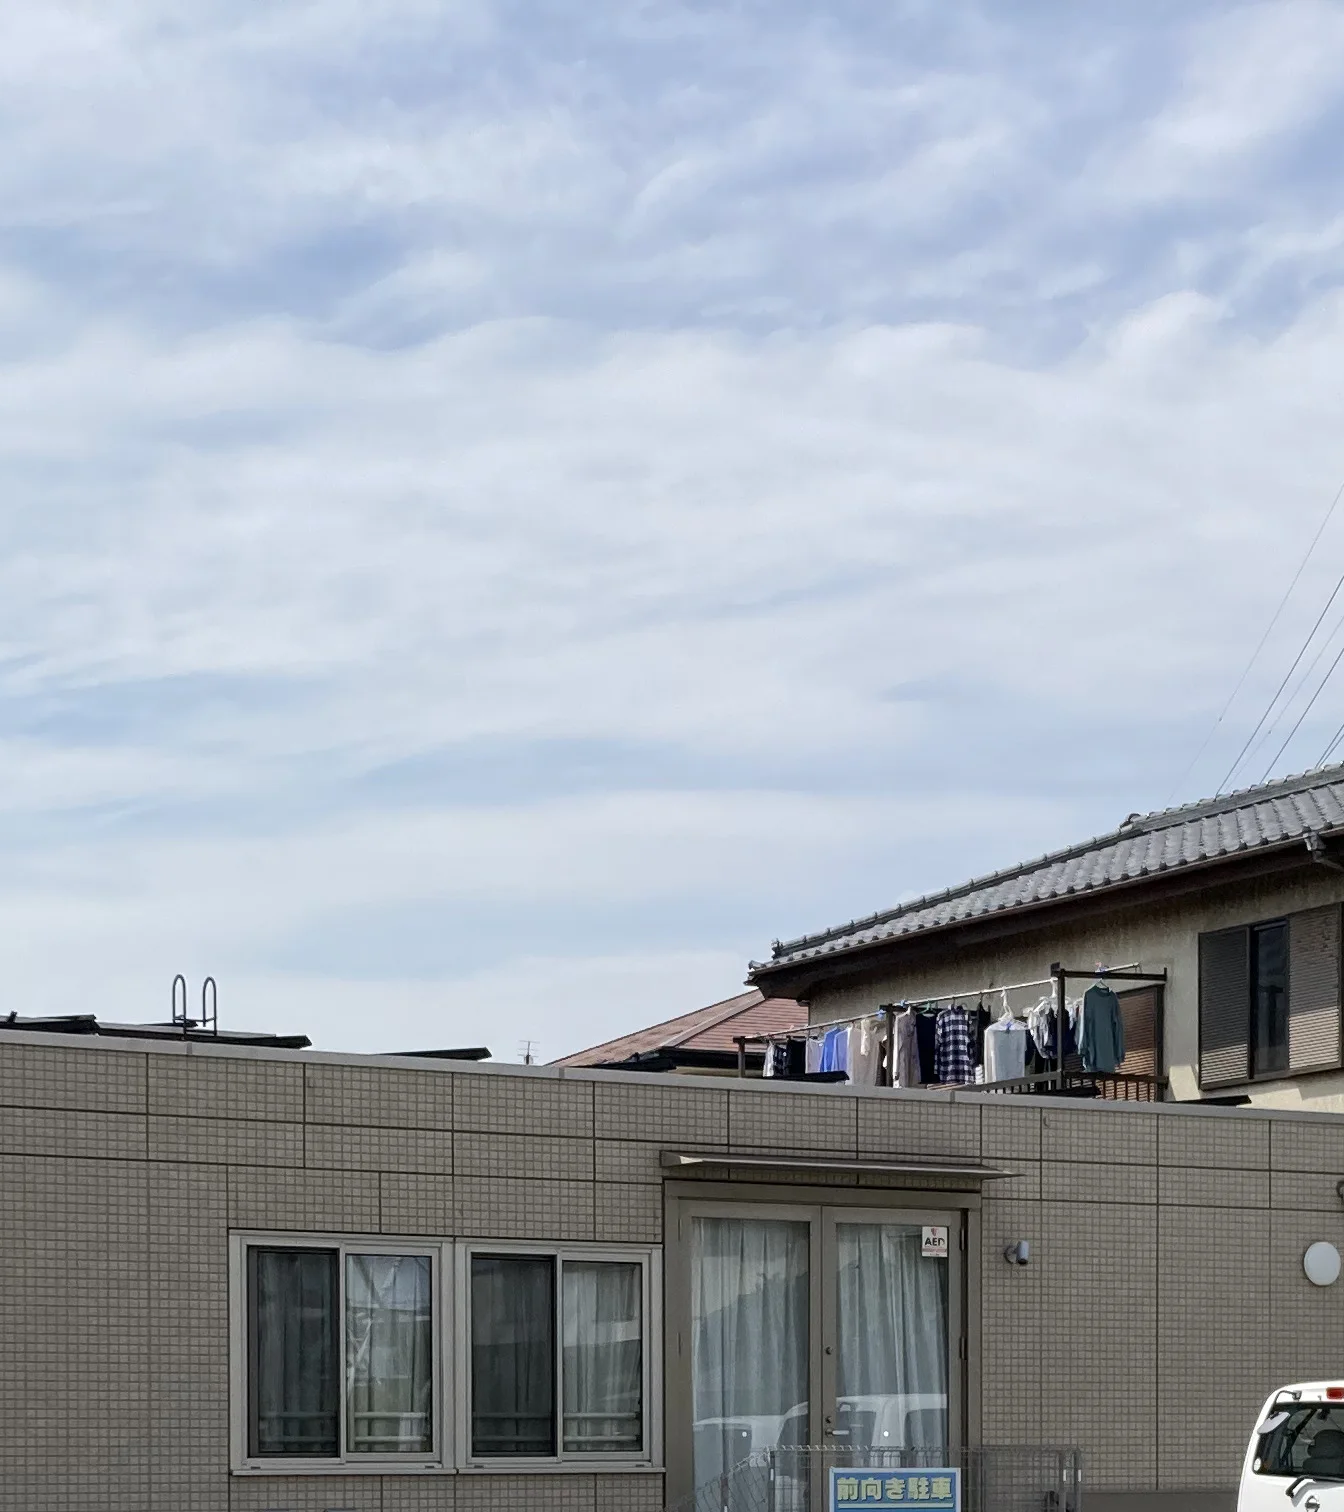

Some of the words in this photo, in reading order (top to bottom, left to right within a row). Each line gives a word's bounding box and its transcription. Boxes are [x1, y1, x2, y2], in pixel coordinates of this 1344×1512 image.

[925, 1237, 945, 1247] AED
[836, 1477, 953, 1501] 前向き駐車
